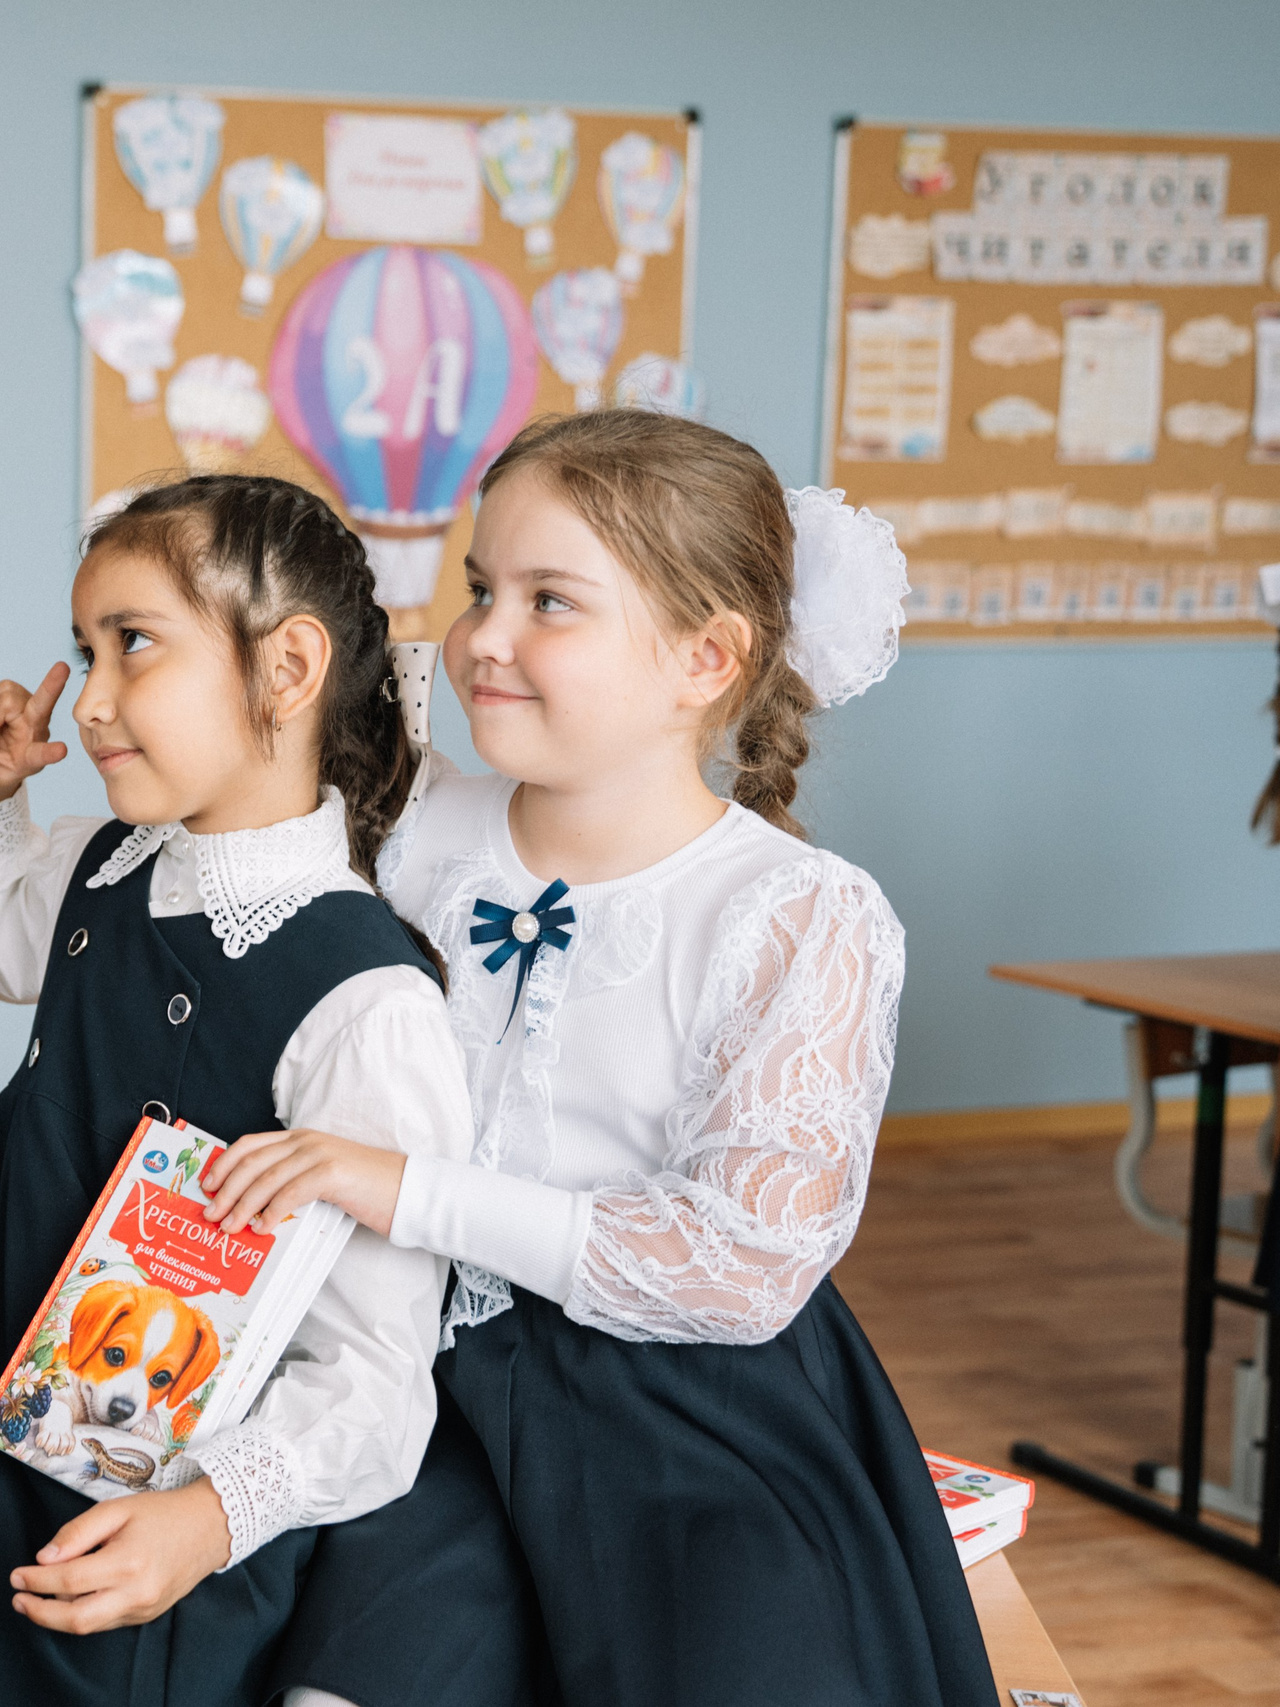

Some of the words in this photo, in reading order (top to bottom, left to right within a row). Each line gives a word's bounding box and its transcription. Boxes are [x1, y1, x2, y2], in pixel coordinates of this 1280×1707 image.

[133, 1242, 155, 1256] для
[155, 1247, 221, 1286] внеклассного
[149, 1261, 198, 1292] ЧТЕНИЯ
